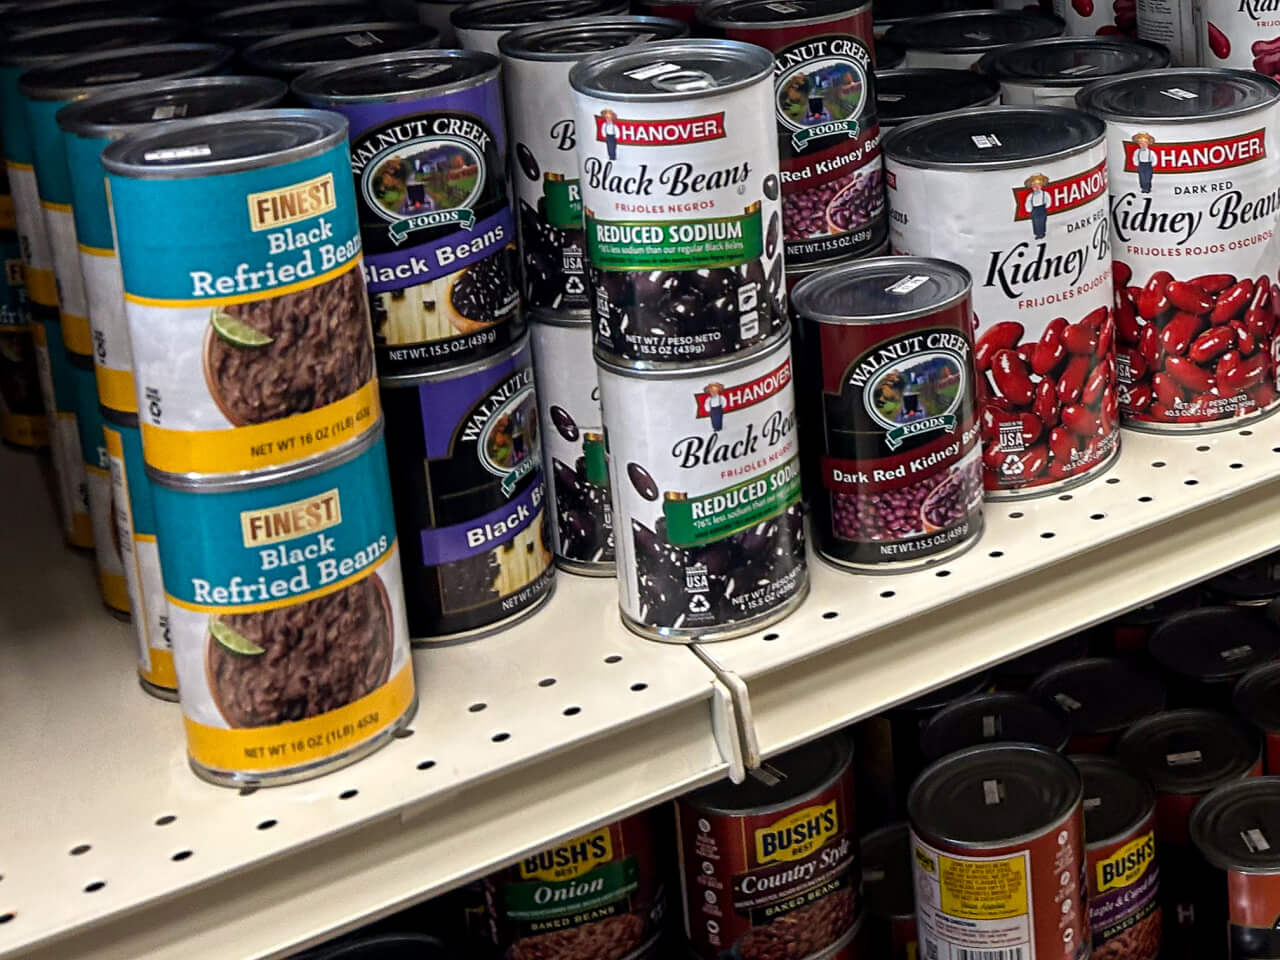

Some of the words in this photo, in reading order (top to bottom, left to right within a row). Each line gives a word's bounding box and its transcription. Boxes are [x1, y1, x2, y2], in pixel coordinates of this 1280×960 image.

[622, 120, 717, 141] HANOVER
[1160, 138, 1259, 168] HANOVER
[585, 157, 653, 194] Black
[660, 161, 751, 195] Beans
[1174, 185, 1205, 195] DARK
[1210, 182, 1232, 192] RED
[257, 181, 332, 223] FINEST
[616, 203, 664, 213] FRIJOLES
[668, 201, 715, 211] NEGROS
[408, 211, 458, 228] FOODS
[597, 225, 663, 243] REDUCED
[669, 222, 742, 241] SODIUM
[268, 218, 332, 255] Black
[435, 225, 504, 265] Beans
[1127, 245, 1180, 257] FRIJOLES
[1185, 242, 1224, 255] ROJOS
[1228, 231, 1272, 252] OSCUROS
[984, 242, 1087, 299] Kidney
[389, 350, 406, 360] NET
[430, 344, 449, 355] 15.5
[729, 365, 790, 408] HANOVER
[903, 417, 945, 434] FOODS
[1000, 434, 1023, 446] USA
[692, 479, 767, 519] REDUCED
[249, 498, 335, 540] FINEST
[466, 505, 530, 548] Black
[260, 534, 335, 571] Black
[881, 544, 896, 555] NET
[192, 569, 309, 604] Refried
[318, 535, 387, 585] Beans
[245, 747, 264, 759] NET
[268, 743, 286, 755] WT
[291, 738, 303, 752] 16
[307, 735, 322, 748] OZ
[762, 809, 836, 856] BUSH'S
[741, 862, 816, 894] Country
[819, 842, 850, 867] Style
[534, 877, 604, 904] Onion
[531, 918, 569, 930] BAKED
[574, 906, 615, 926] BEANS
